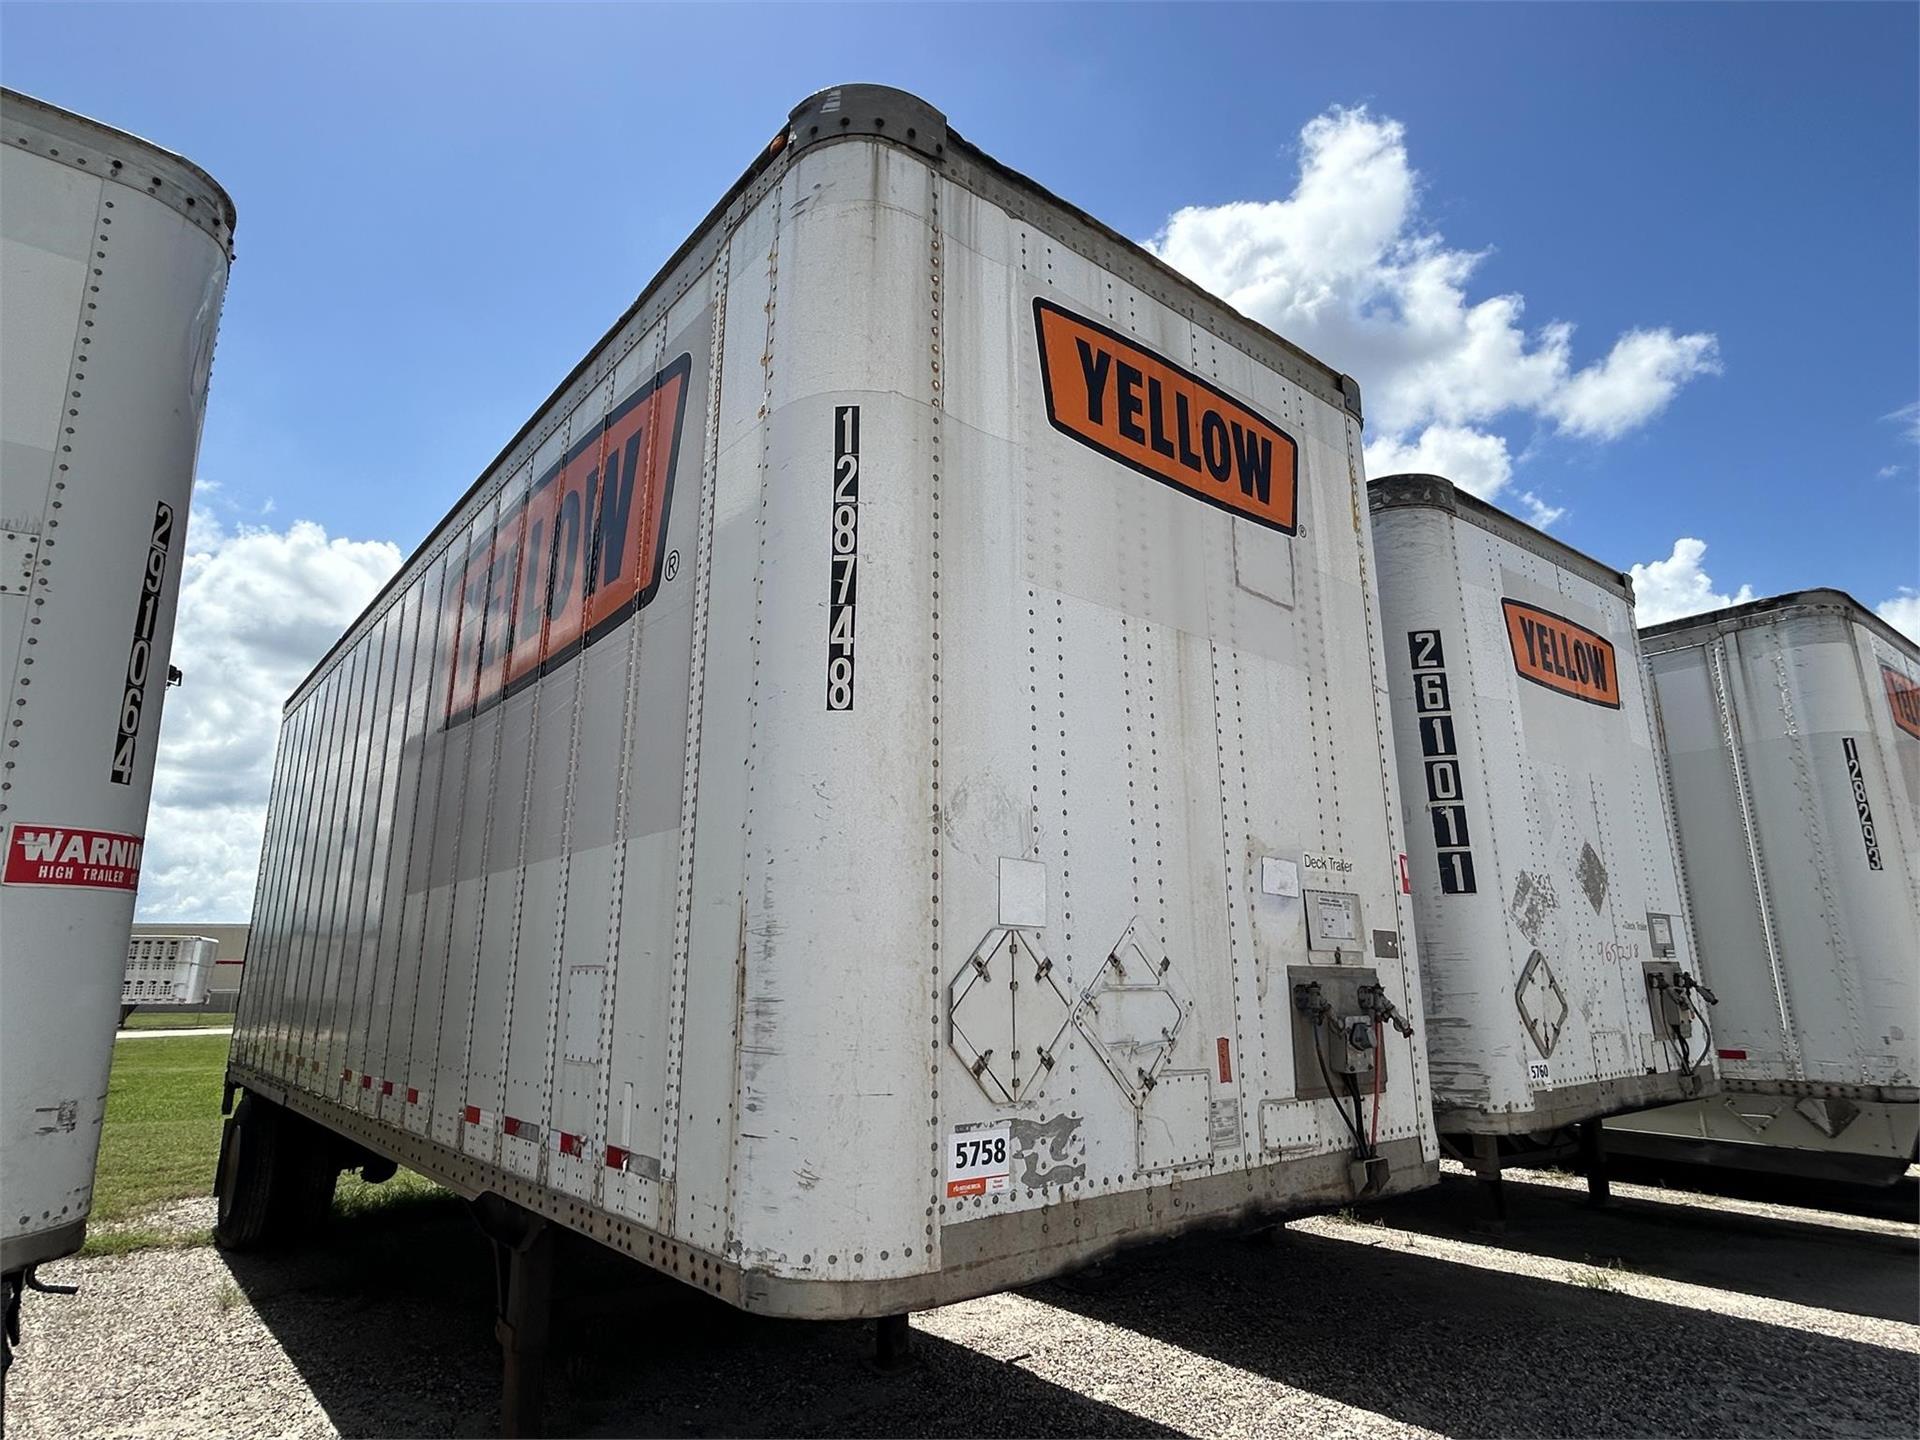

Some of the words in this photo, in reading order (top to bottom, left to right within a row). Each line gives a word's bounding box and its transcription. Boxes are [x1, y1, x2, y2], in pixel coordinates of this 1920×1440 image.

[1075, 336, 1272, 505] YELLOW
[829, 407, 858, 710] 128748
[114, 504, 172, 784] 291064
[1519, 616, 1607, 692] YELLOW
[1414, 632, 1465, 892] 261011
[1846, 738, 1882, 870] 128293
[39, 866, 73, 879] HIGH
[83, 868, 124, 882] TRAILER
[1304, 854, 1326, 869] Deck
[1329, 857, 1352, 872] Trailer
[1530, 1064, 1548, 1079] 5760
[956, 1138, 1006, 1169] 5758
